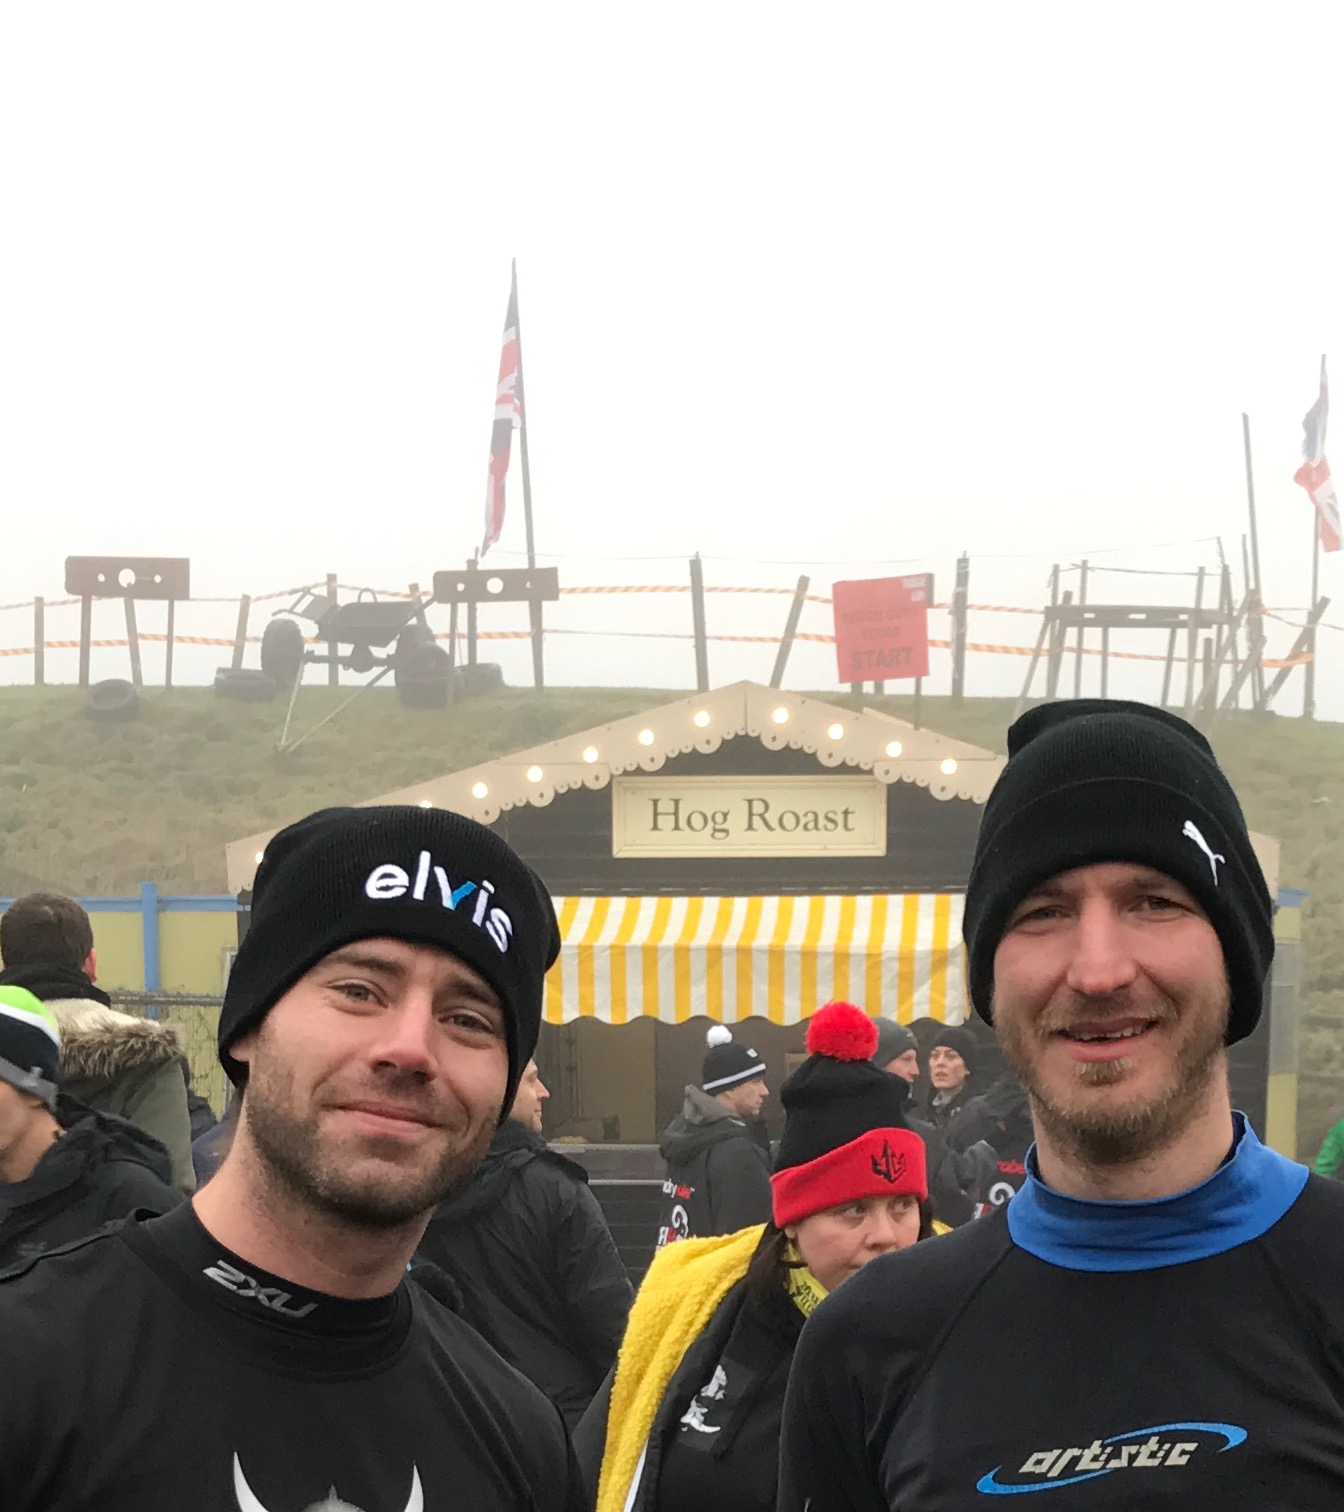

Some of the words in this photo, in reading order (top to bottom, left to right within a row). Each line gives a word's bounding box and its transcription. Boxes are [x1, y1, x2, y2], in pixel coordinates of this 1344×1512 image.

[851, 647, 913, 671] START
[649, 798, 730, 840] Hog
[743, 797, 856, 832] Roast
[365, 850, 513, 953] elvis
[203, 1260, 319, 1318] 2XU
[1019, 1436, 1198, 1477] artistic
